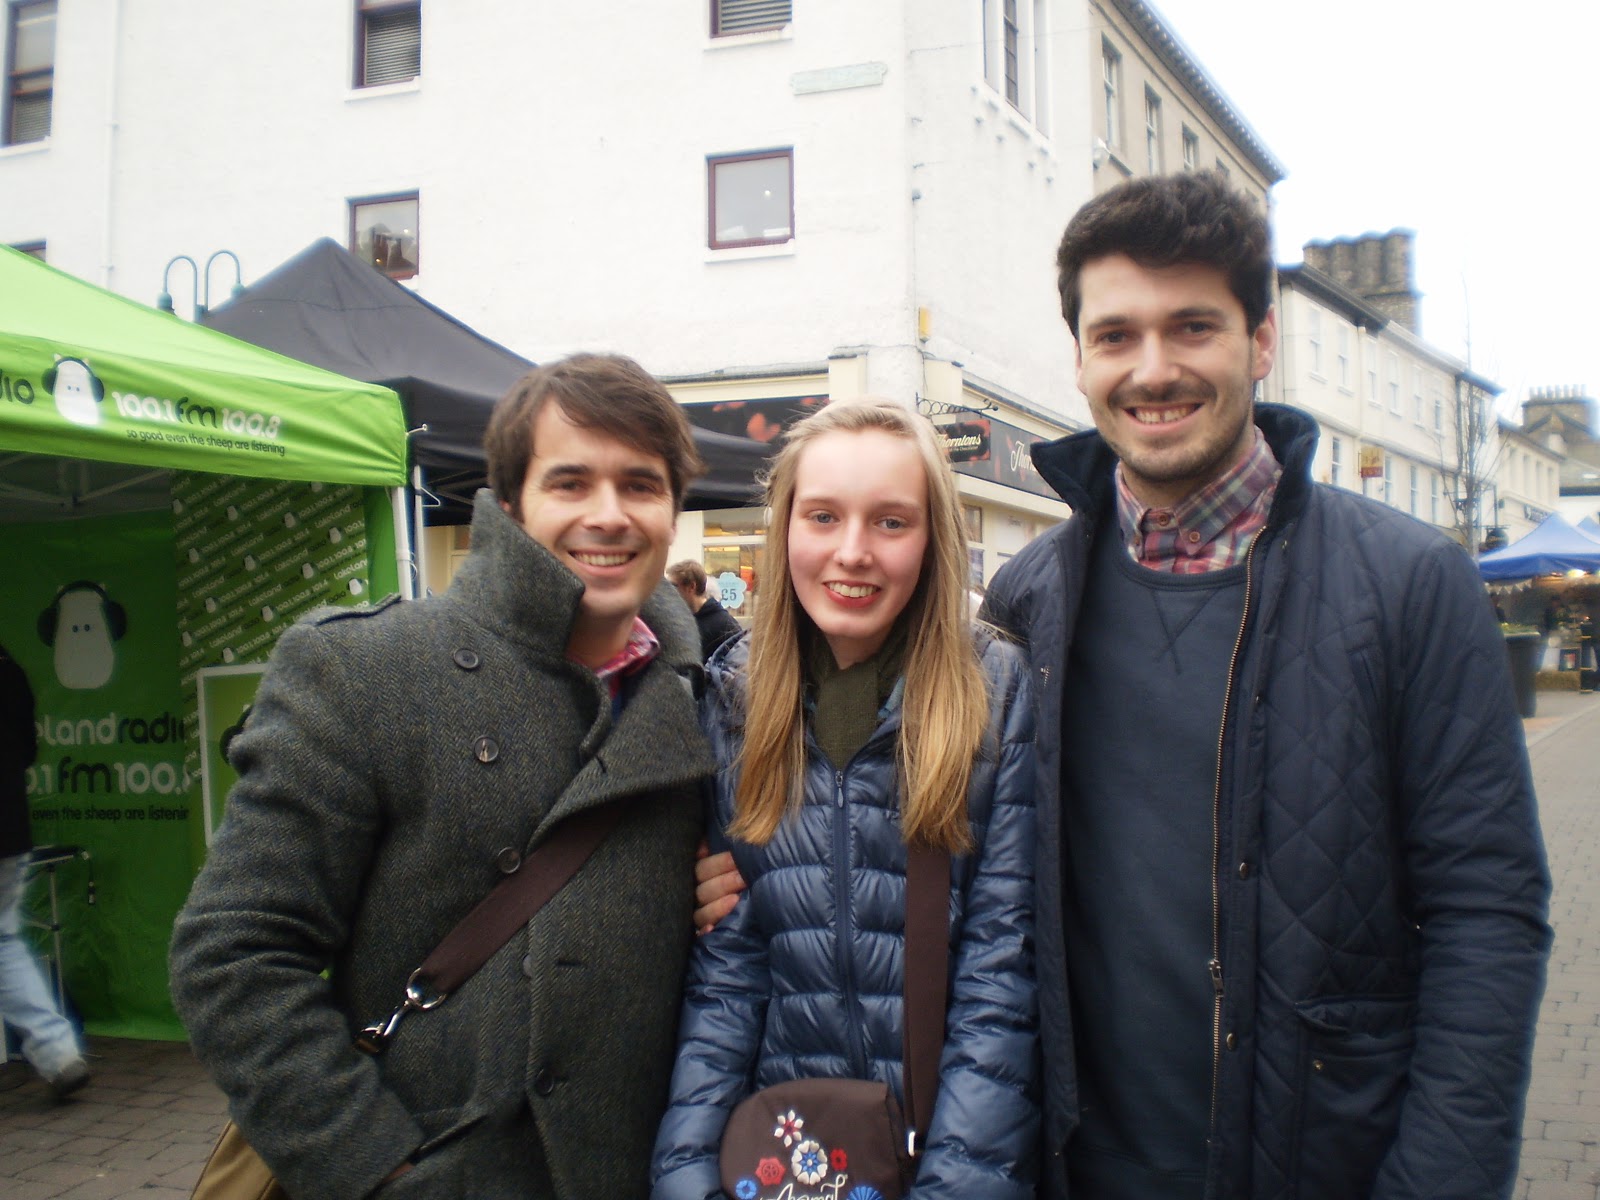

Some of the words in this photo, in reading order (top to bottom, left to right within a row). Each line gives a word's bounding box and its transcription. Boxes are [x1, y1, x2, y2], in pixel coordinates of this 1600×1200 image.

[0, 369, 35, 404] io
[111, 391, 176, 422] 100.1
[221, 407, 281, 439] 100.8
[126, 428, 138, 438] so
[140, 431, 164, 442] good
[166, 433, 188, 443] even
[189, 433, 205, 445] the
[207, 435, 233, 450] sheep
[234, 440, 250, 450] are
[251, 439, 285, 457] listening
[721, 588, 737, 601] £5
[57, 756, 112, 794] fm
[31, 808, 59, 820] even
[62, 806, 81, 821] the
[84, 805, 122, 822] sheep
[125, 808, 145, 821] are
